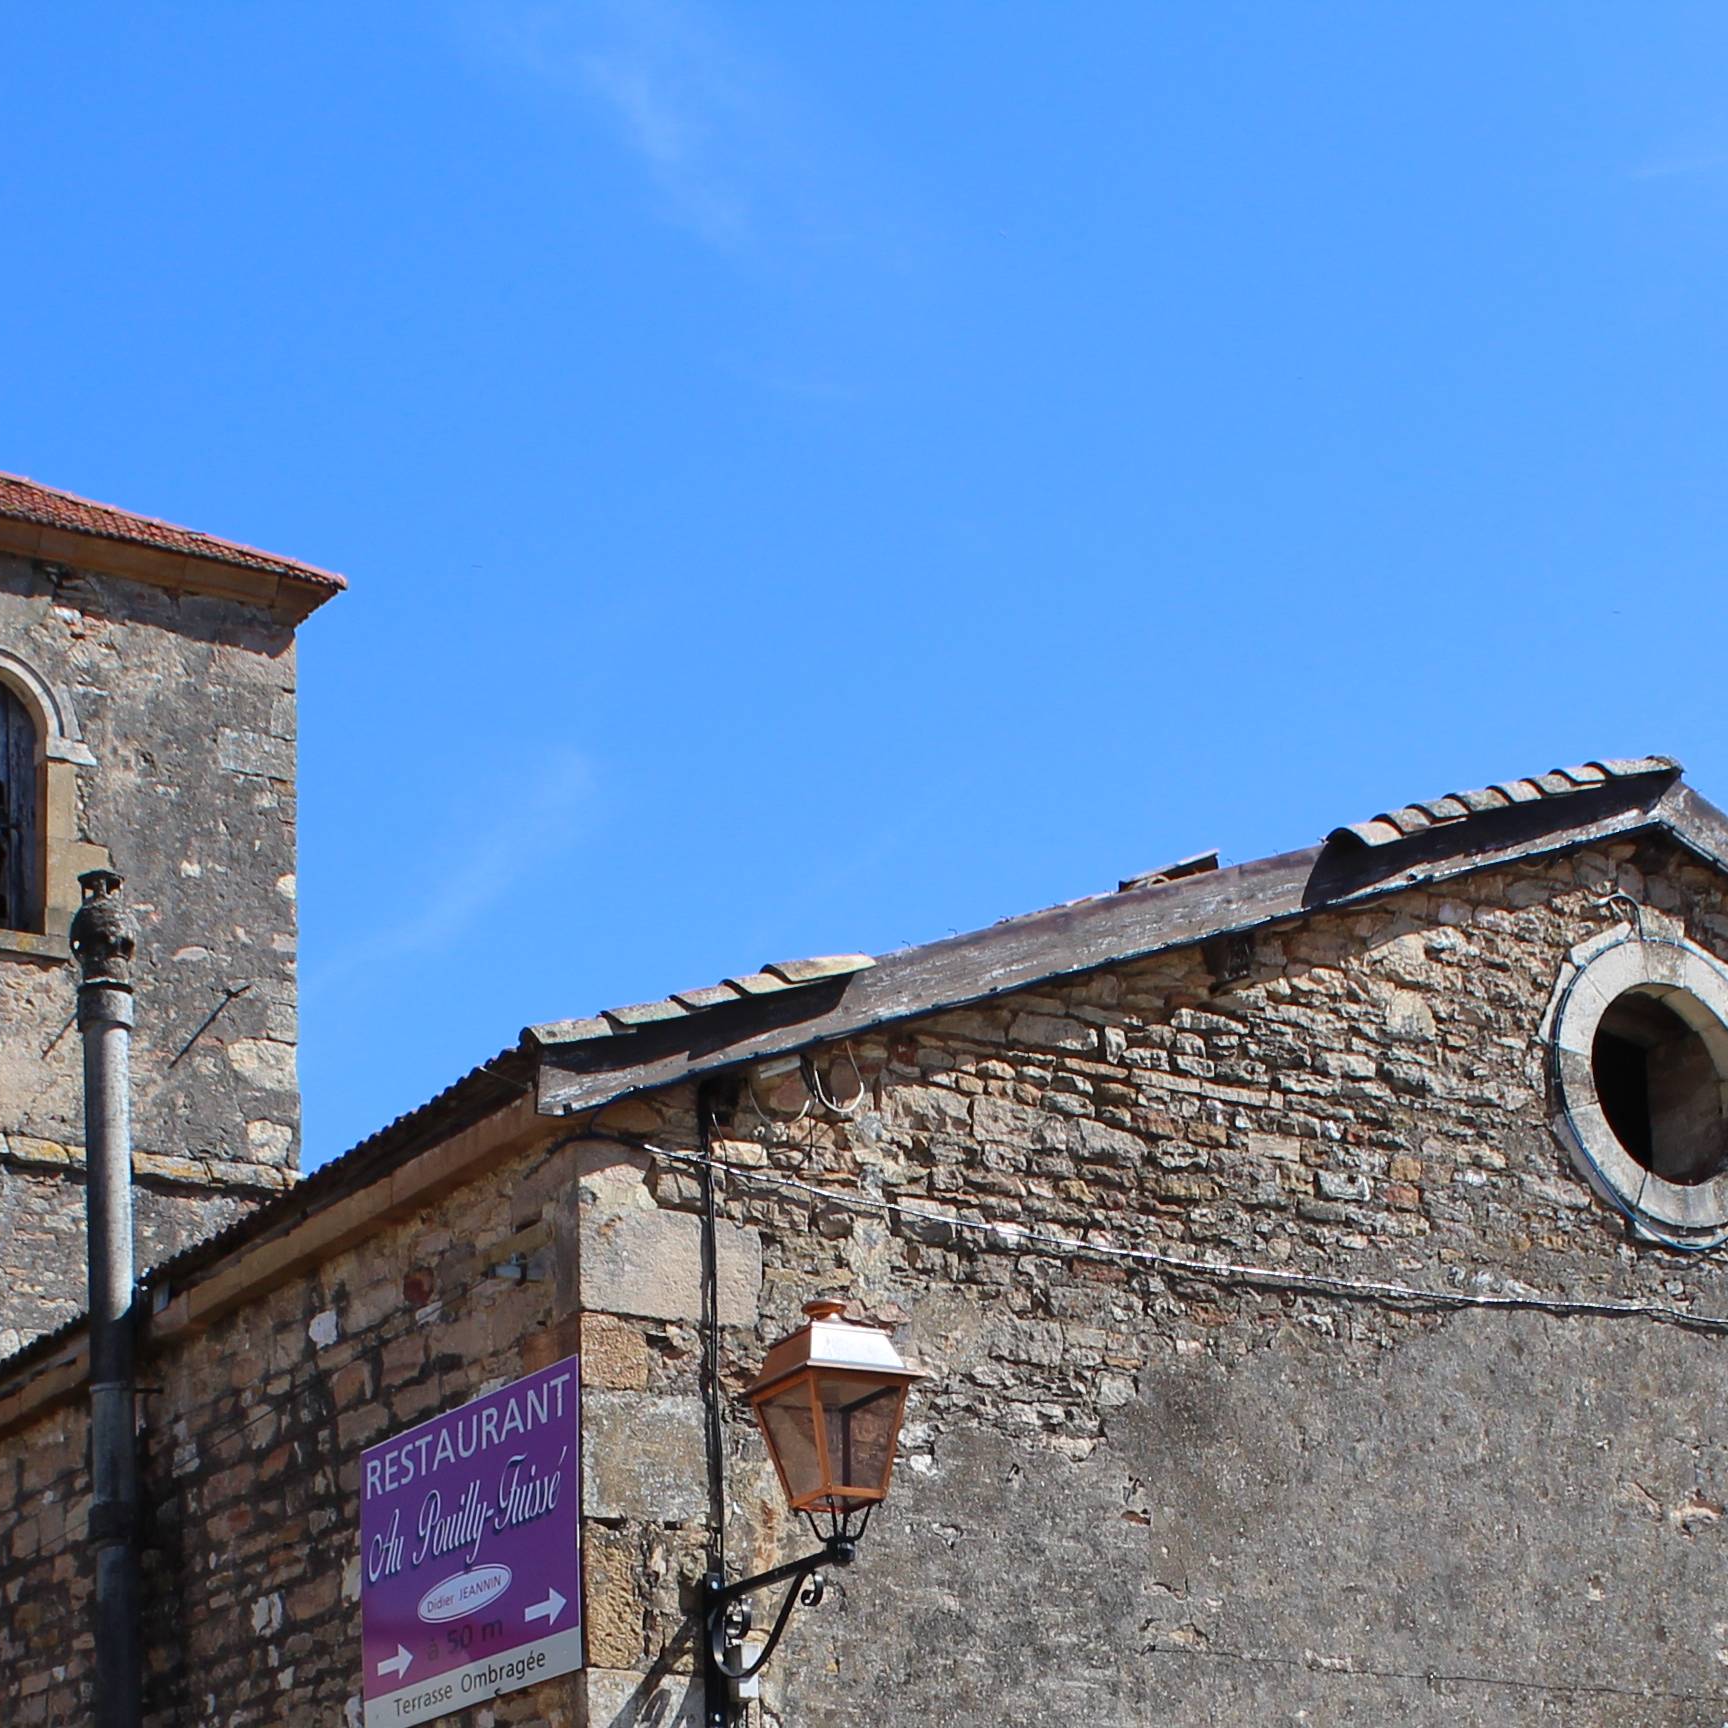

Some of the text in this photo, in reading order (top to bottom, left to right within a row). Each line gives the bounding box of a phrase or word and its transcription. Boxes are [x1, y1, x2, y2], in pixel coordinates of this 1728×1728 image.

[367, 1373, 570, 1500] RESTAURANT
[369, 1446, 567, 1582] Au Pouilly-Fuissé
[427, 1575, 502, 1613] Didier JEANNIN
[447, 1624, 472, 1651] 50
[482, 1619, 503, 1641] m
[394, 1650, 545, 1716] Terrasse Ombragée
